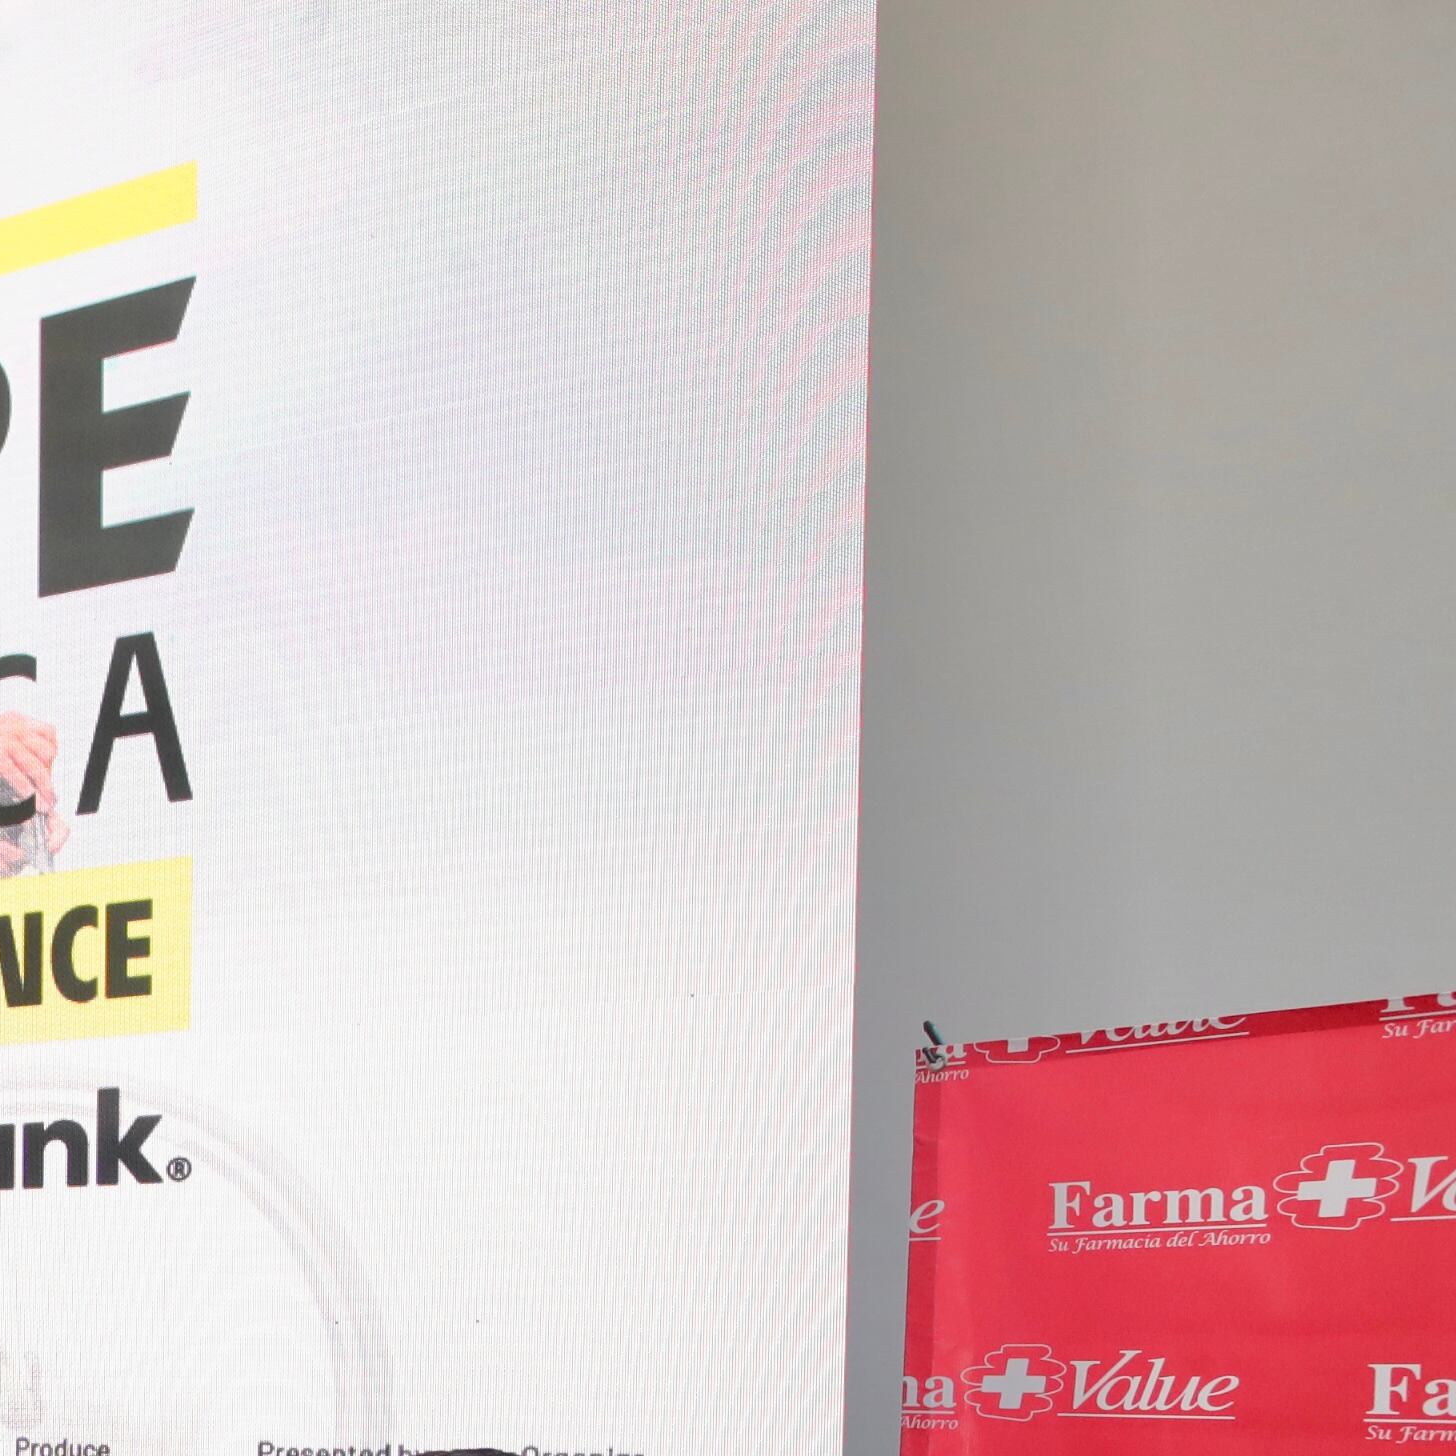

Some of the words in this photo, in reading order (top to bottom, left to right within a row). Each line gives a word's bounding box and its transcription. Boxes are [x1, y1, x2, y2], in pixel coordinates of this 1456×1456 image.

[1382, 1022, 1408, 1039] Su
[1048, 1179, 1268, 1230] Farma
[1049, 1235, 1069, 1252] Su
[1072, 1234, 1161, 1255] Farmacia
[1166, 1231, 1195, 1248] del
[1198, 1230, 1271, 1248] Ahorro
[1069, 1350, 1239, 1413] Value
[1366, 1425, 1391, 1441] Su
[1396, 1424, 1456, 1445] Farm
